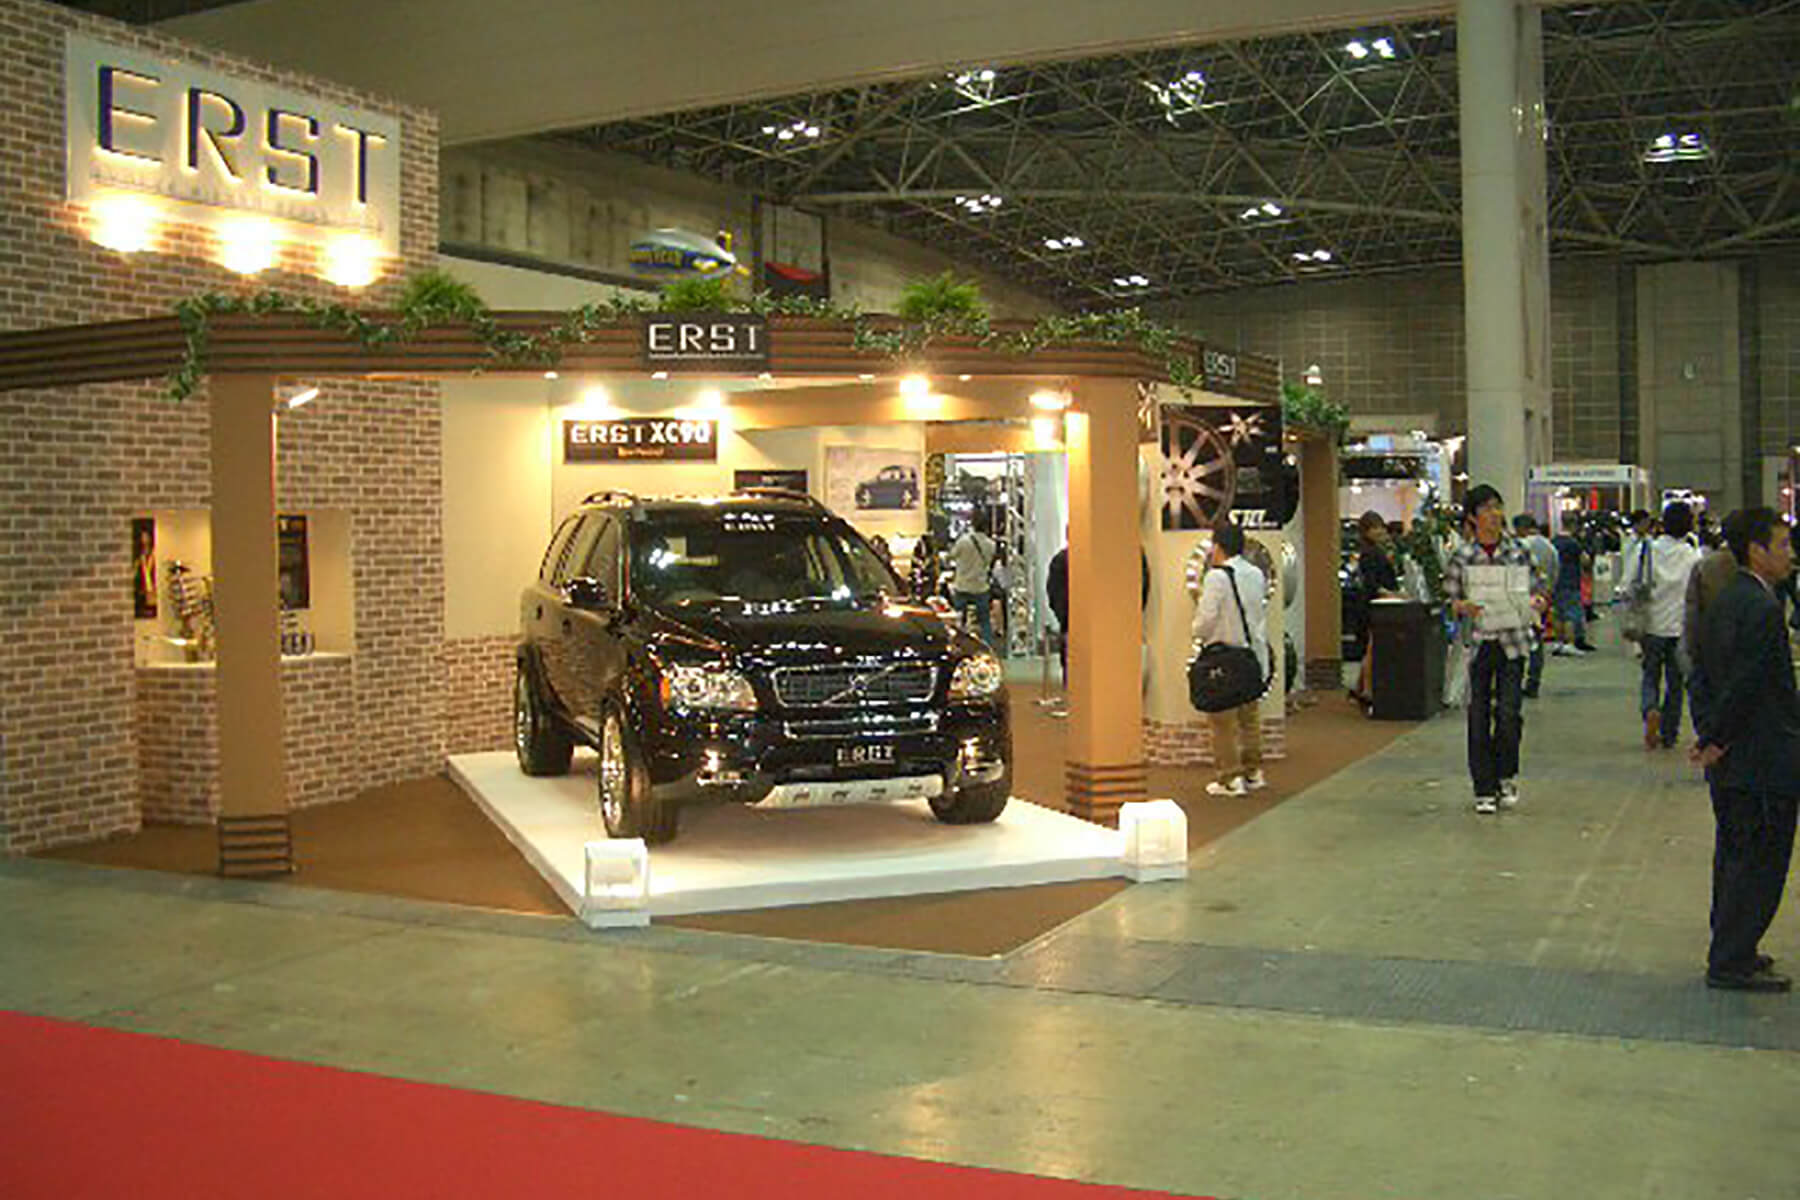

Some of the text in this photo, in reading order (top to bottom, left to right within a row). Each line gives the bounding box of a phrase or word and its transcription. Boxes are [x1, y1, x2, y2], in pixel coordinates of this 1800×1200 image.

[97, 65, 387, 204] ERST
[648, 323, 763, 351] ERST
[571, 424, 645, 444] ERST
